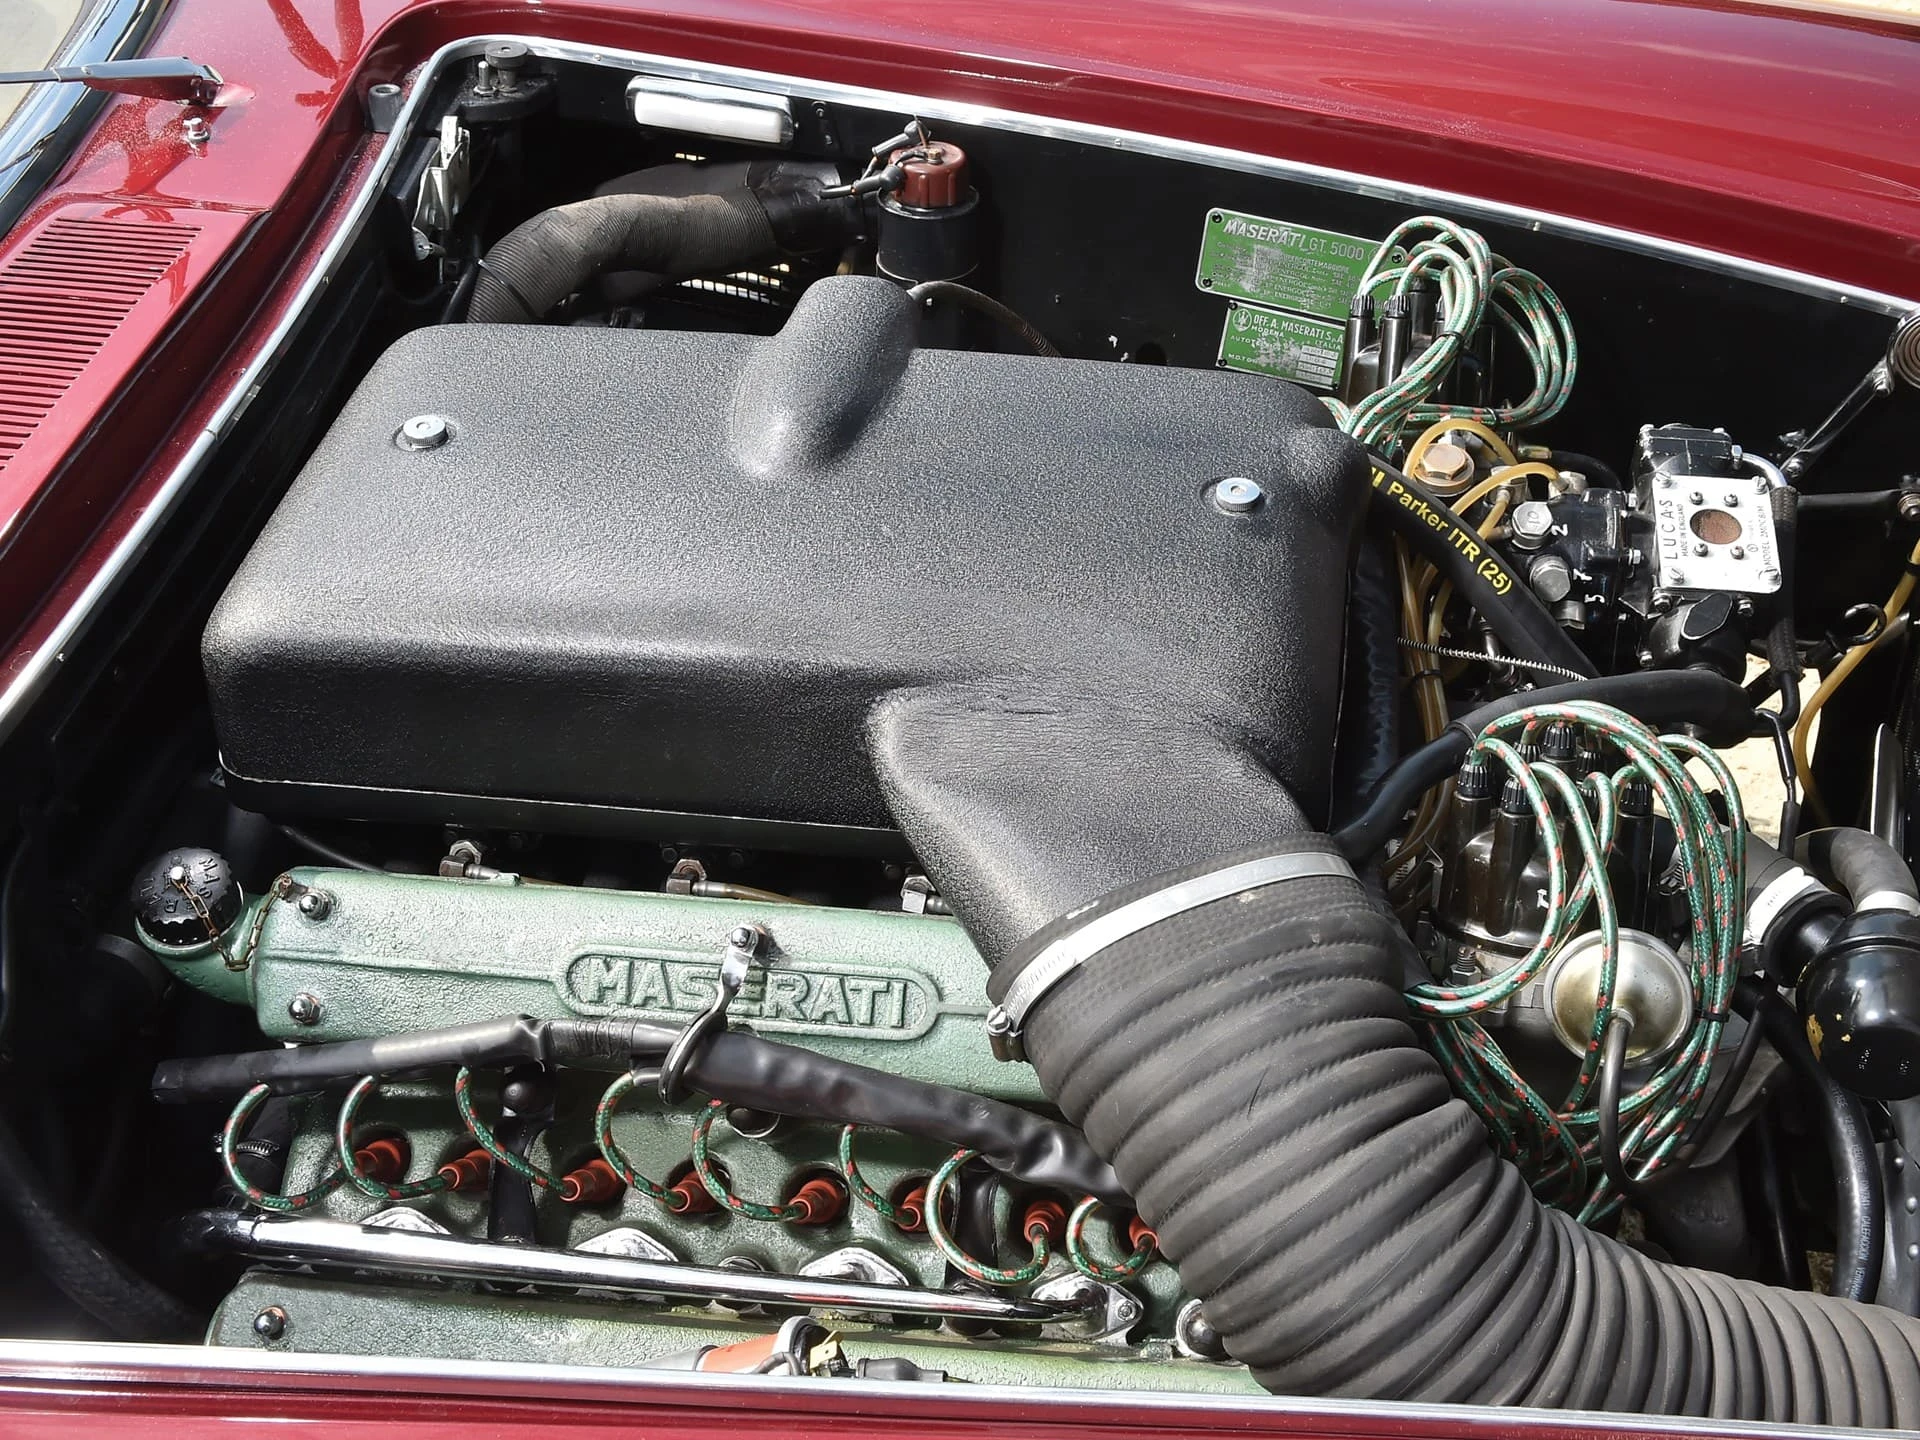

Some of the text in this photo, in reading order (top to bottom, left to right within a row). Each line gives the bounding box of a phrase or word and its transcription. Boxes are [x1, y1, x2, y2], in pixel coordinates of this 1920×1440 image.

[1223, 220, 1304, 248] MASERATI
[1330, 241, 1365, 260] 5000
[1281, 321, 1324, 339] MASERATI
[1659, 499, 1678, 560] LUCAS
[1676, 503, 1686, 530] ENGLAND
[1387, 481, 1512, 595] Parker ITR (25)
[1680, 540, 1688, 557] MADE
[583, 958, 906, 1028] MASERATI
